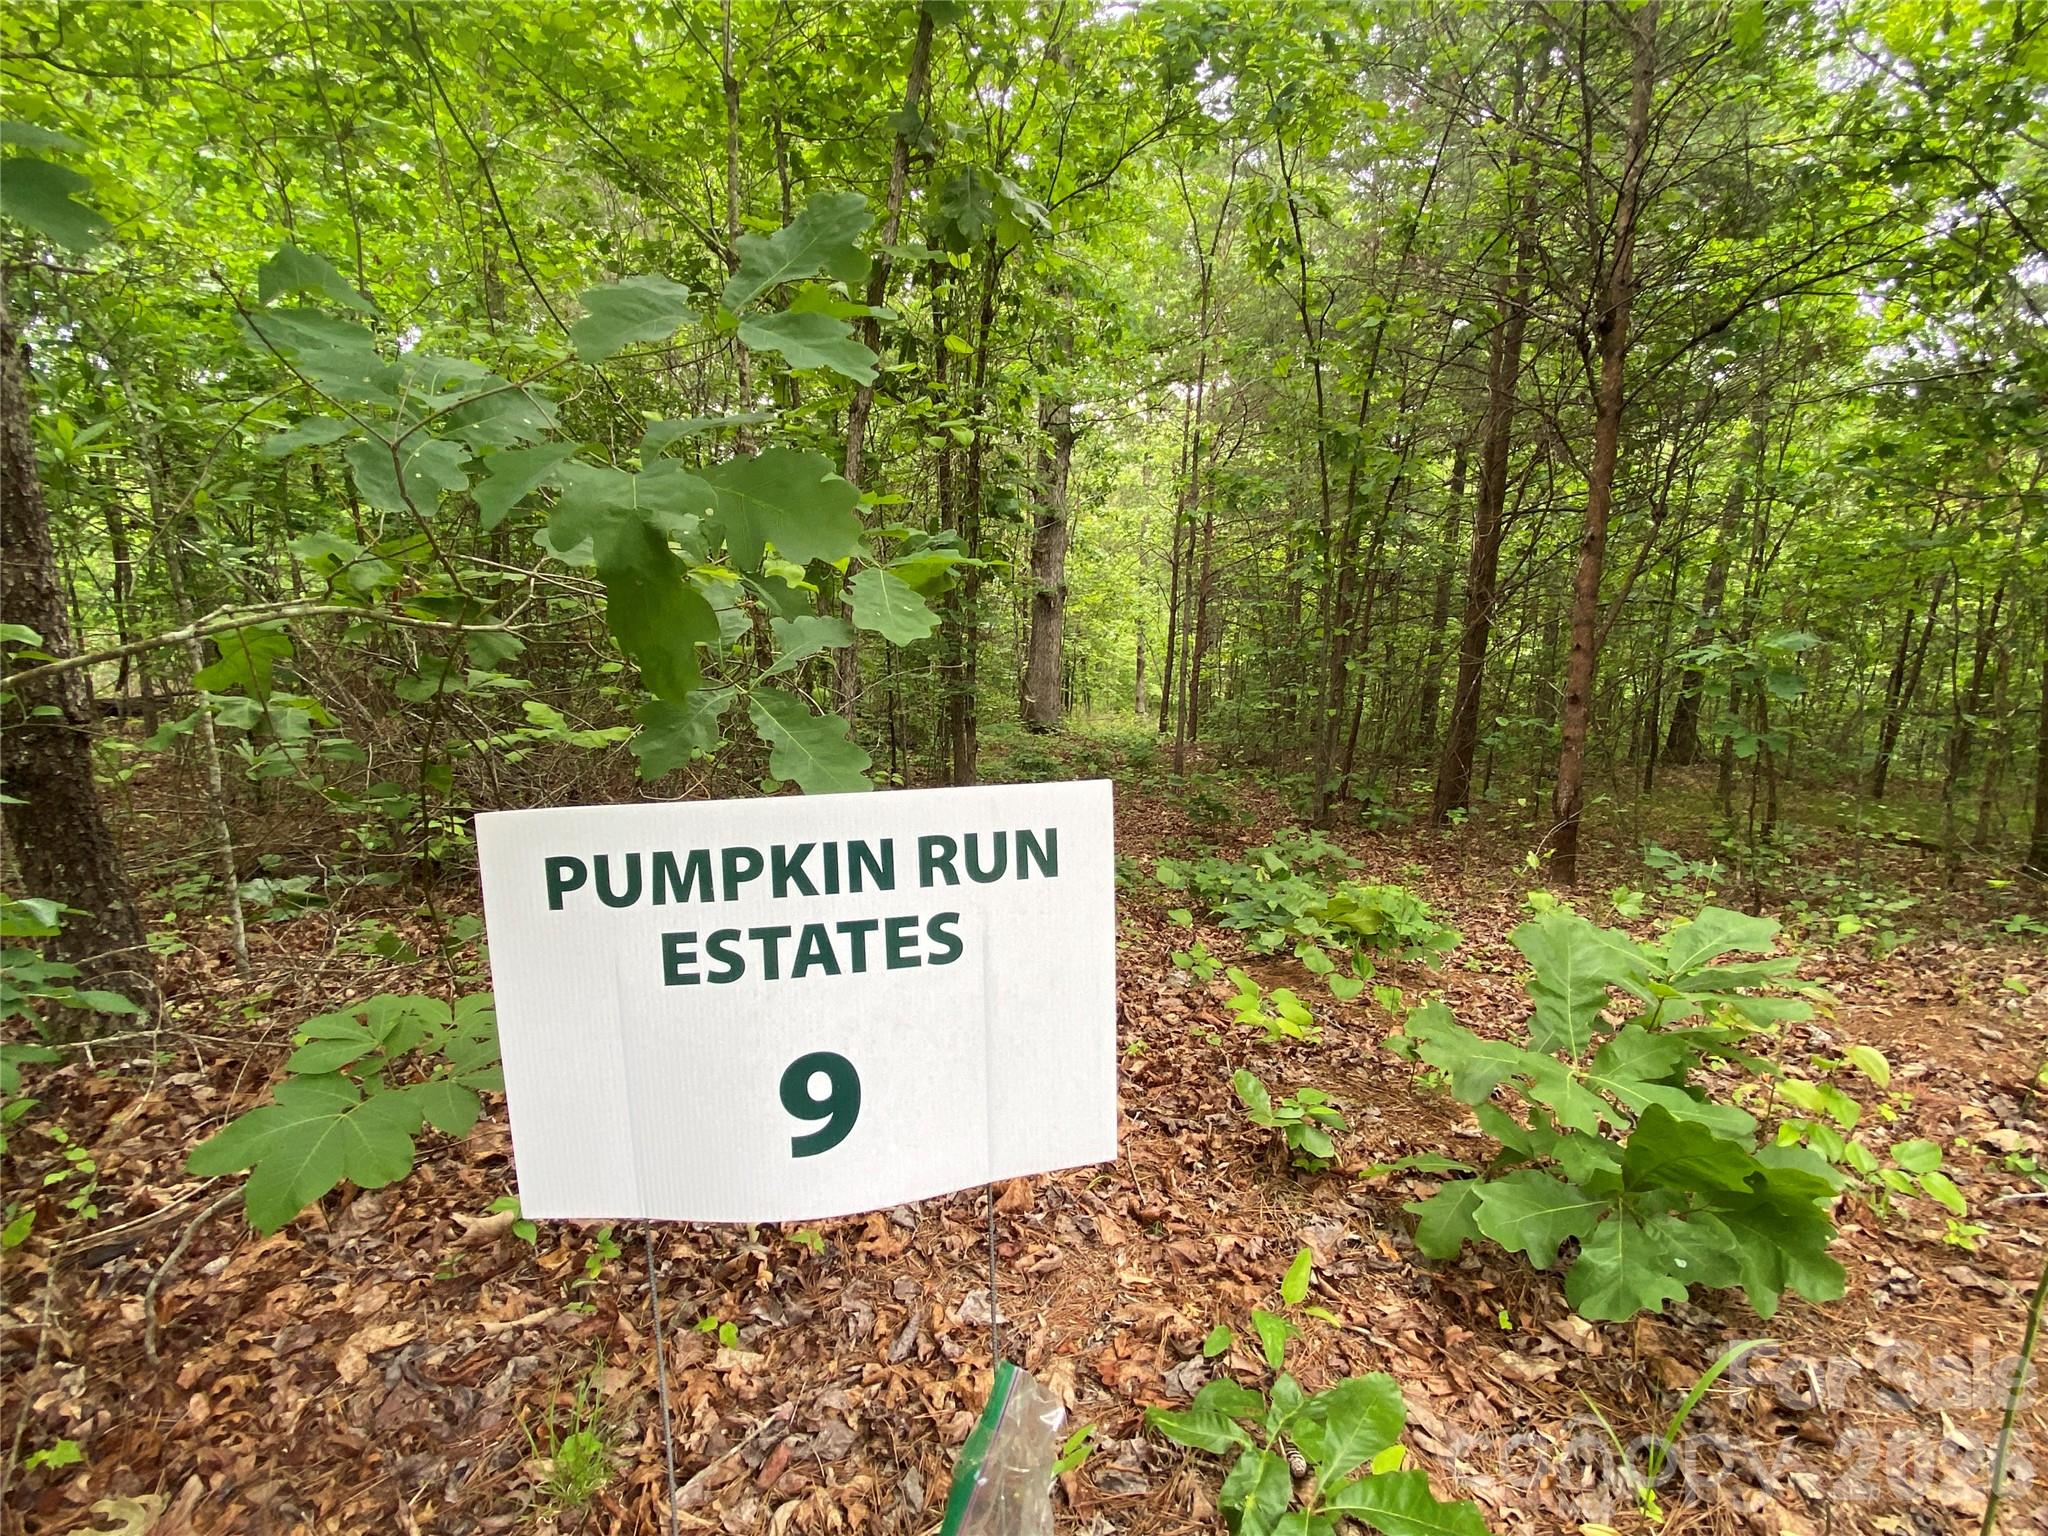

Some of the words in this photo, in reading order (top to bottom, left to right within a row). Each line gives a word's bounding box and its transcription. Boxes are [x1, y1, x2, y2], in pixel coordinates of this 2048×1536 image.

[545, 839, 895, 911] PUMPKIN
[918, 827, 1059, 888] RUN
[661, 912, 964, 986] ESTATES
[779, 1051, 862, 1159] 9
